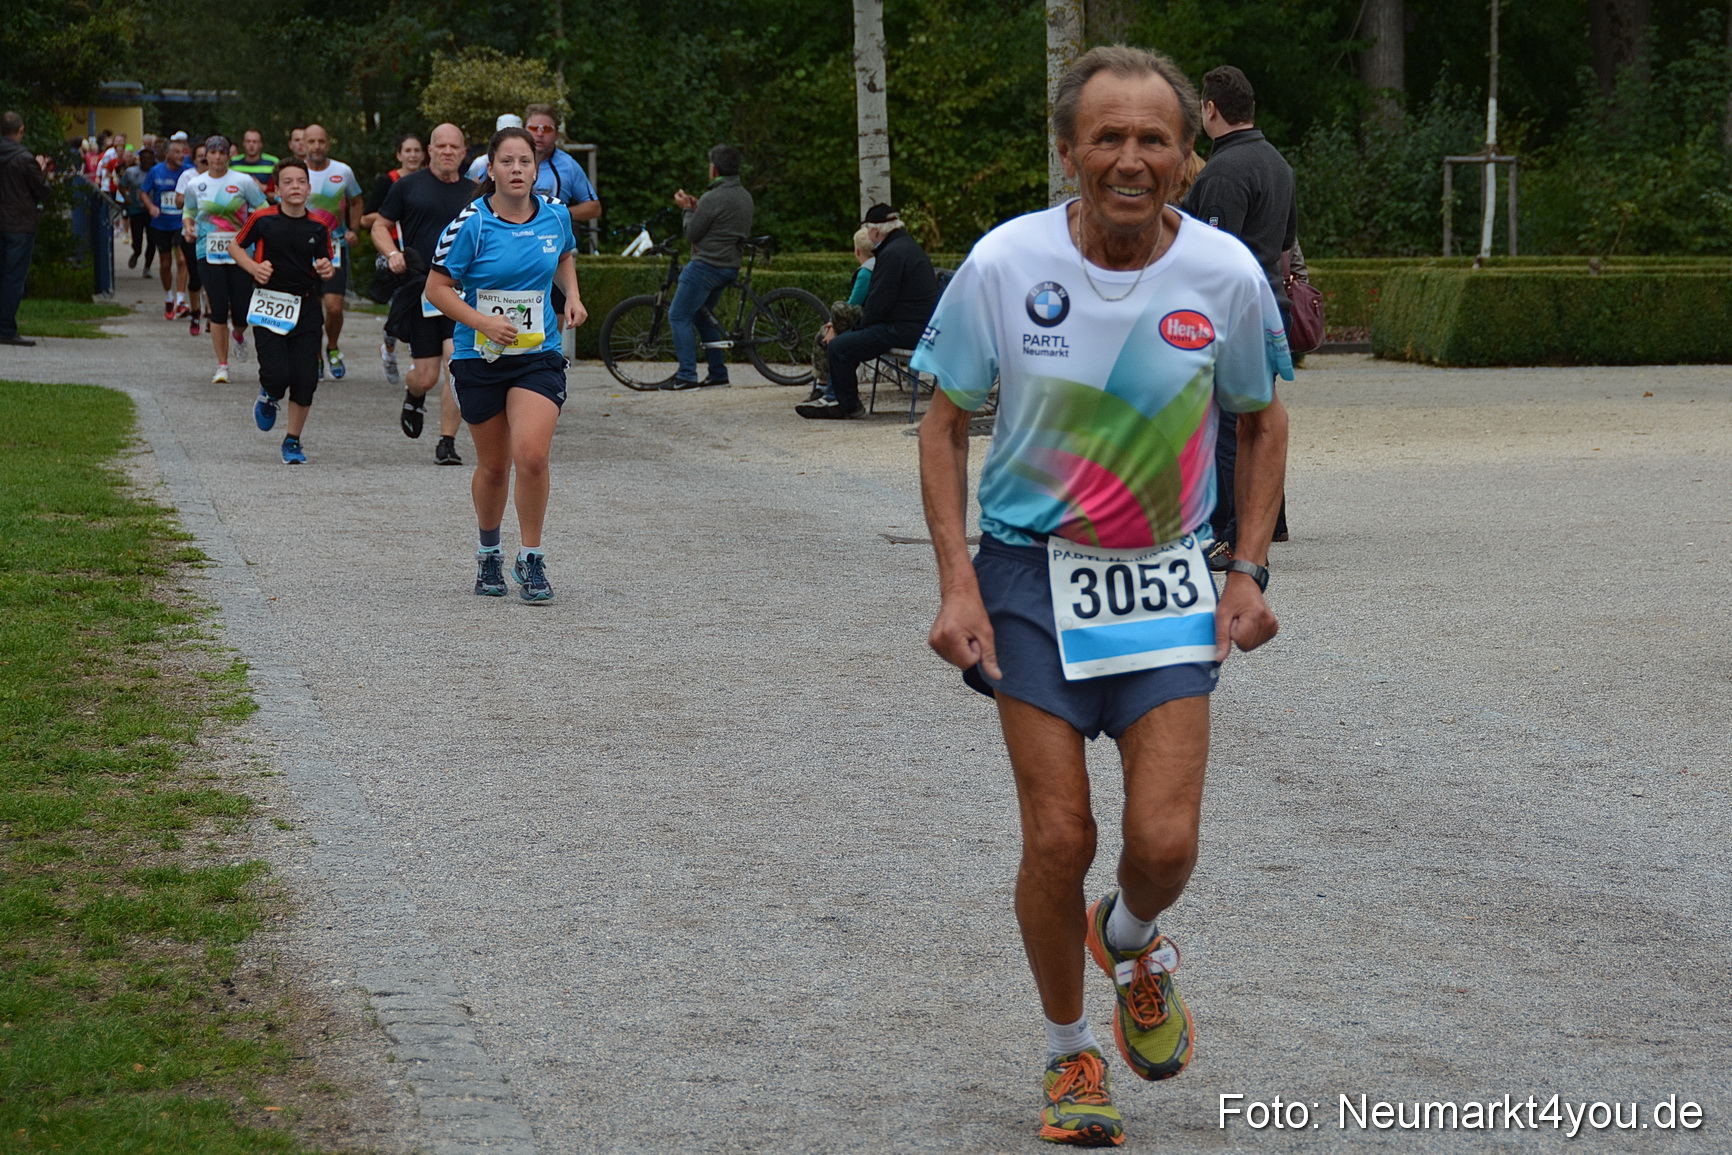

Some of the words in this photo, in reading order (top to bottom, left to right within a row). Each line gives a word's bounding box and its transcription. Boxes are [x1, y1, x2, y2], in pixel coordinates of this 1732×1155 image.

[478, 294, 502, 303] PARTL
[254, 299, 295, 320] 2520
[1022, 333, 1070, 349] PARTL
[1022, 346, 1070, 358] Neumarkt
[1070, 558, 1199, 620] 3053
